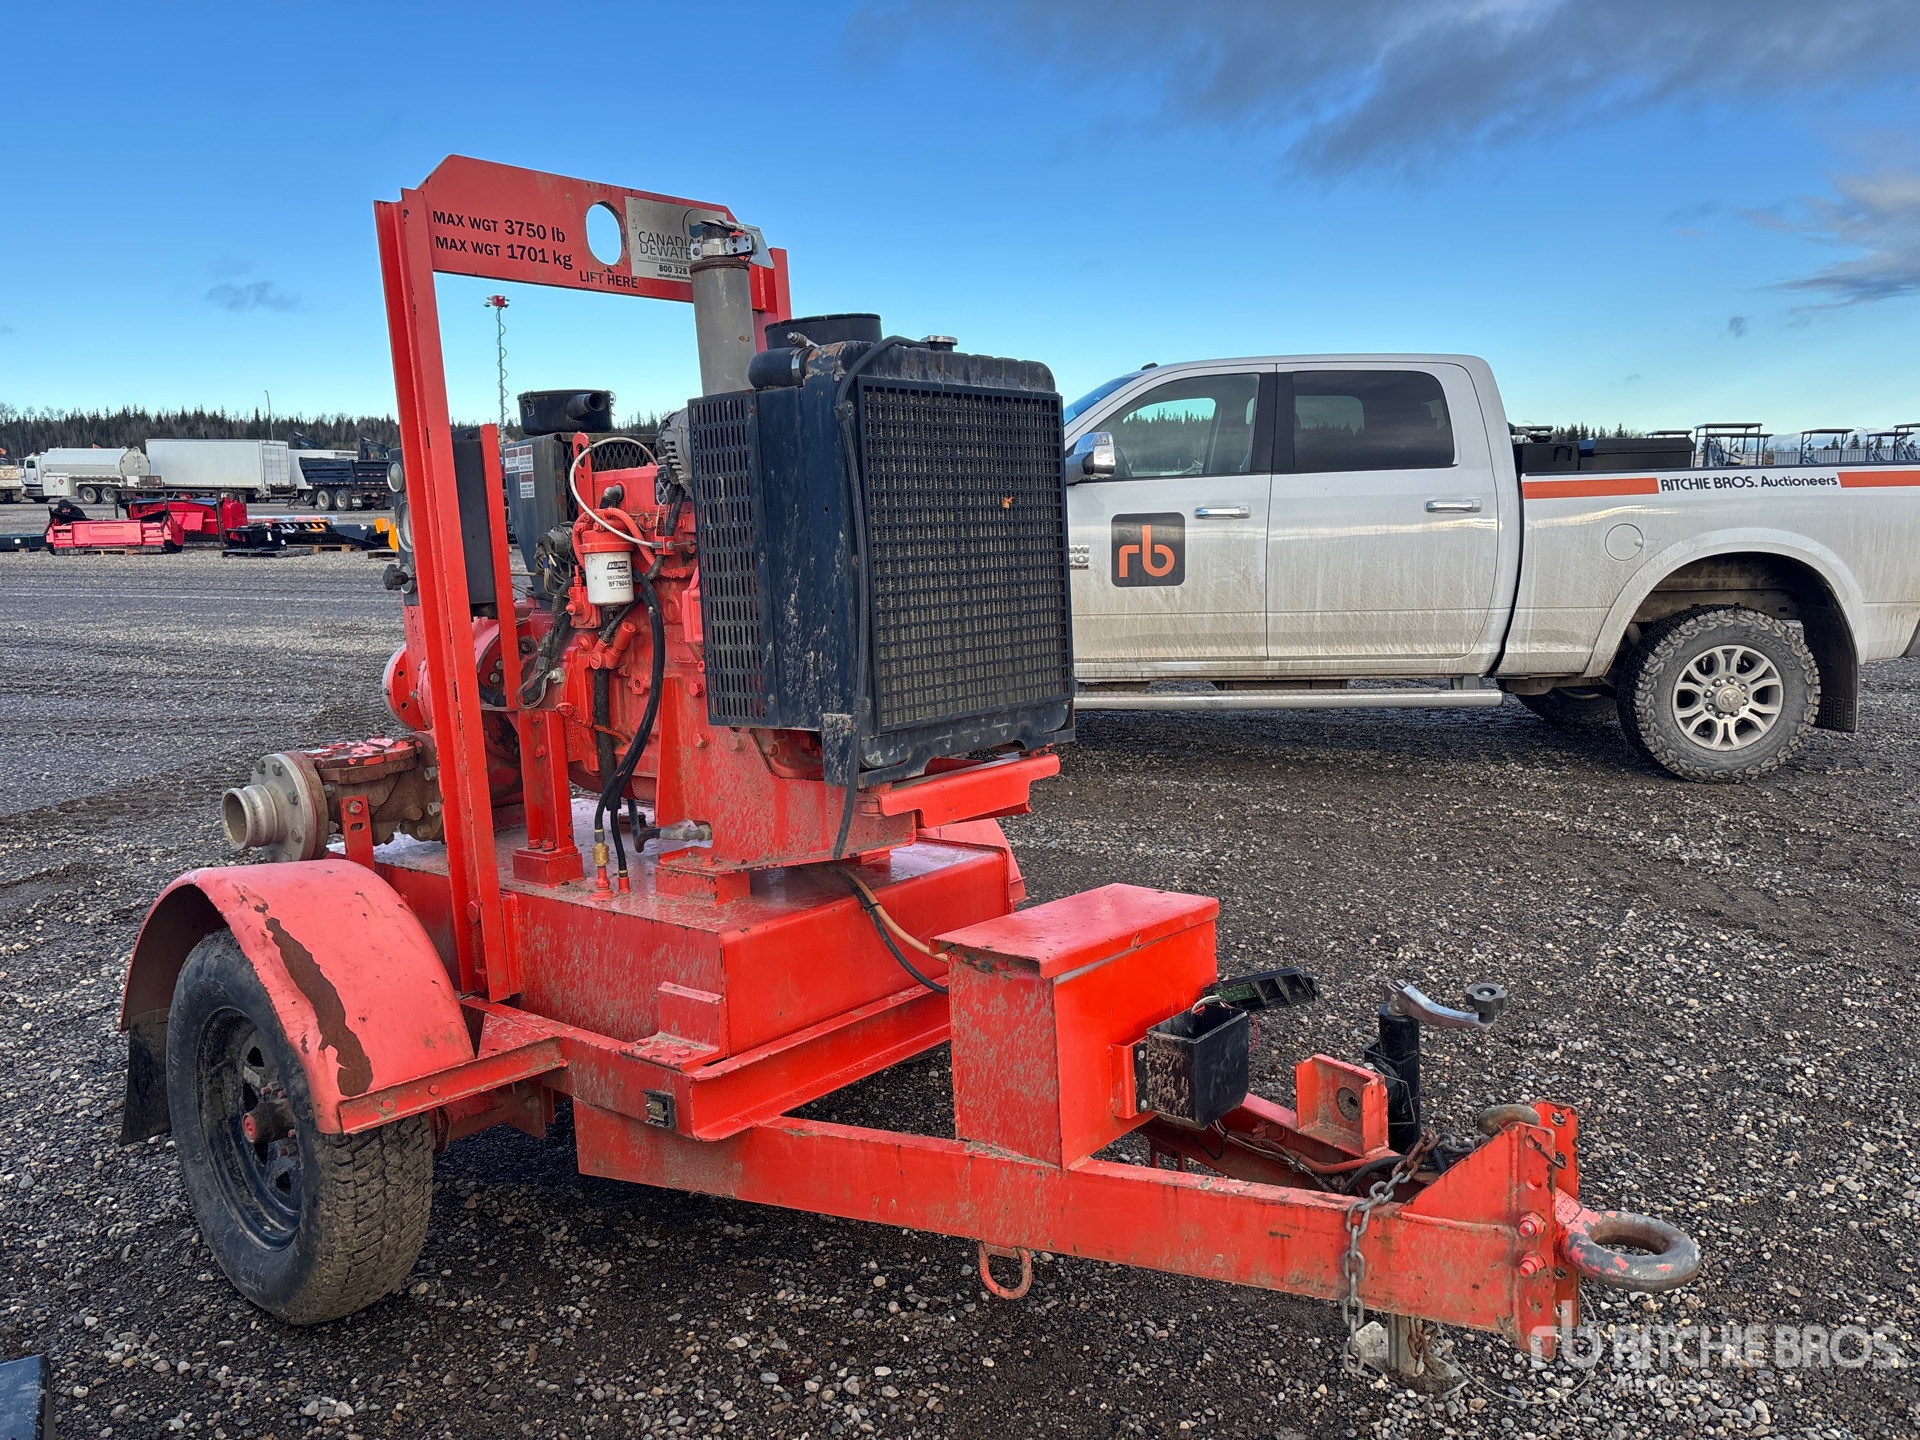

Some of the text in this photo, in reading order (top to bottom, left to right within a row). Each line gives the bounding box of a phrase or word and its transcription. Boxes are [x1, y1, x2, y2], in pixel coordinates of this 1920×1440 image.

[432, 210, 566, 243] MAX WGT 3750 lb
[638, 231, 701, 247] CANADIA
[435, 236, 574, 270] MAX WGT 1701 kg
[640, 243, 692, 260] DEWATE
[658, 265, 688, 275] 800 328
[579, 270, 639, 289] LIFT HERE
[1660, 475, 1838, 492] RITCHIE BROS. Auctioneers
[1118, 524, 1175, 577] rb
